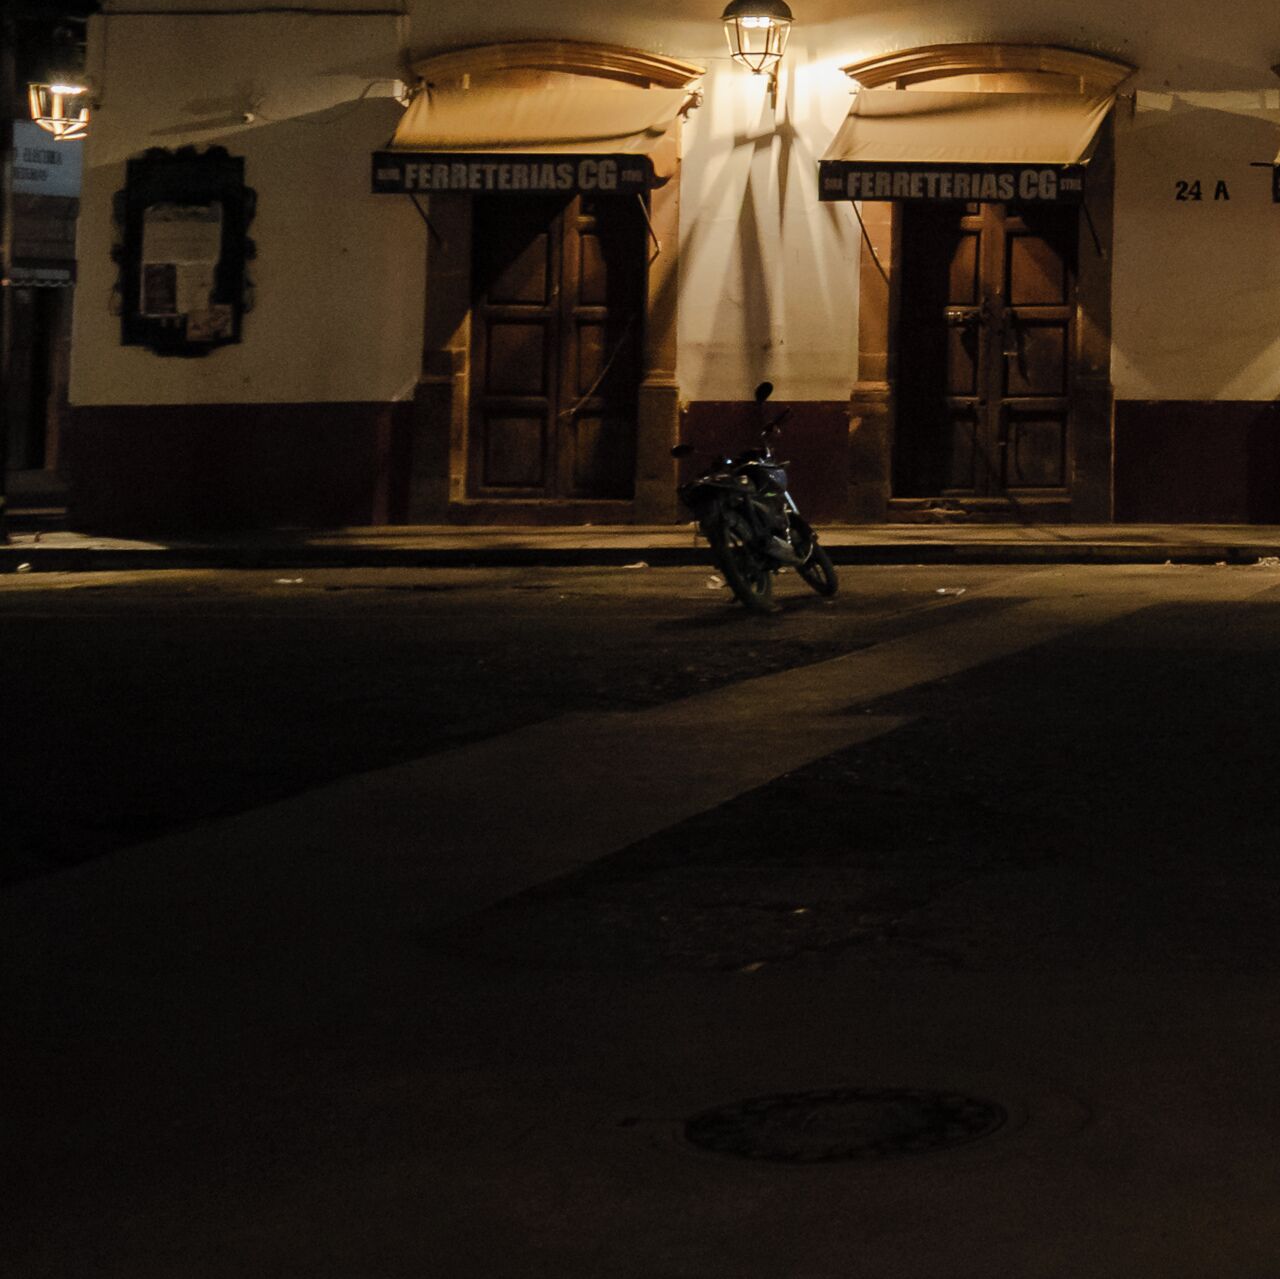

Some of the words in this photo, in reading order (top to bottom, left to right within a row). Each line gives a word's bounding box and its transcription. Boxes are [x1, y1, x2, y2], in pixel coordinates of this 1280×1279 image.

[404, 162, 574, 190] FERRETERIAS
[578, 159, 617, 190] CG
[847, 171, 1015, 199] FERRETERIAS
[1019, 169, 1057, 200] CG
[1175, 180, 1202, 200] 24
[1215, 180, 1229, 200] A
